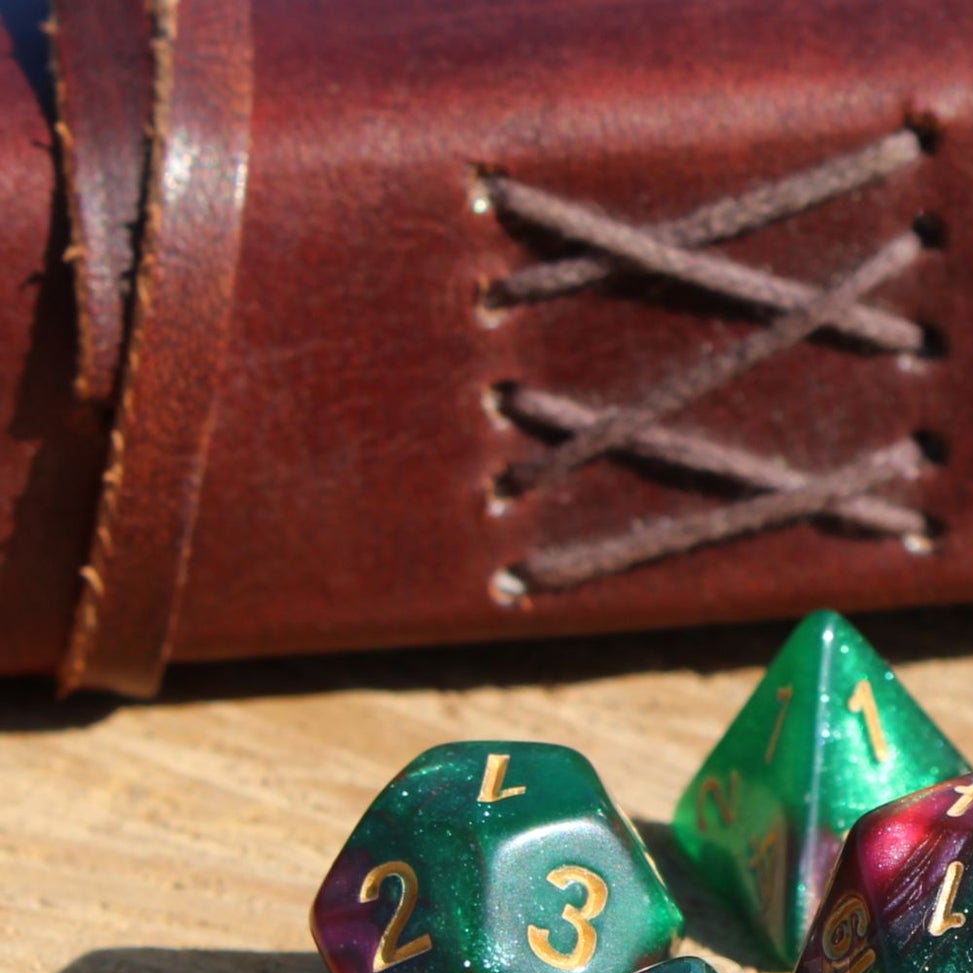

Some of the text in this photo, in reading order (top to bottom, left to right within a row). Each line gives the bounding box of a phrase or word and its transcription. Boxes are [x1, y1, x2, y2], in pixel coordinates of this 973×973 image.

[765, 684, 793, 764] 1
[848, 679, 889, 763] 1
[359, 860, 432, 973] 2
[527, 864, 609, 971] 3
[929, 861, 966, 936] 1
